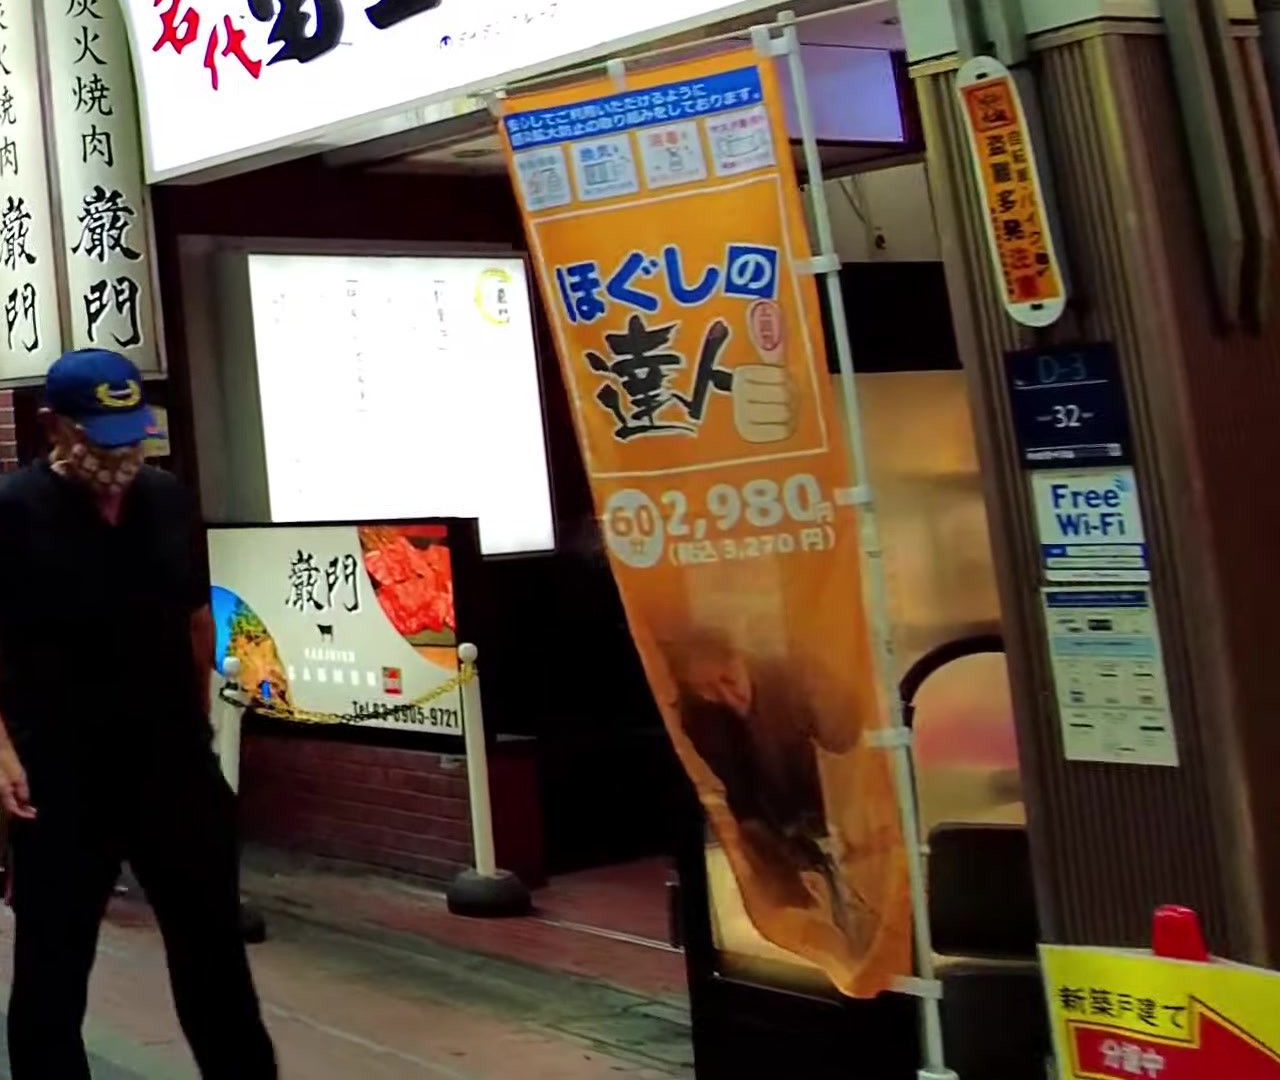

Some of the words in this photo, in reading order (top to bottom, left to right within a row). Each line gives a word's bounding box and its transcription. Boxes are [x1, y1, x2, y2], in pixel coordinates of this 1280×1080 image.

[555, 246, 775, 324] ほぐしの
[582, 313, 737, 442] 達人
[1050, 484, 1122, 509] Free
[1055, 512, 1127, 537] Wi-Fi
